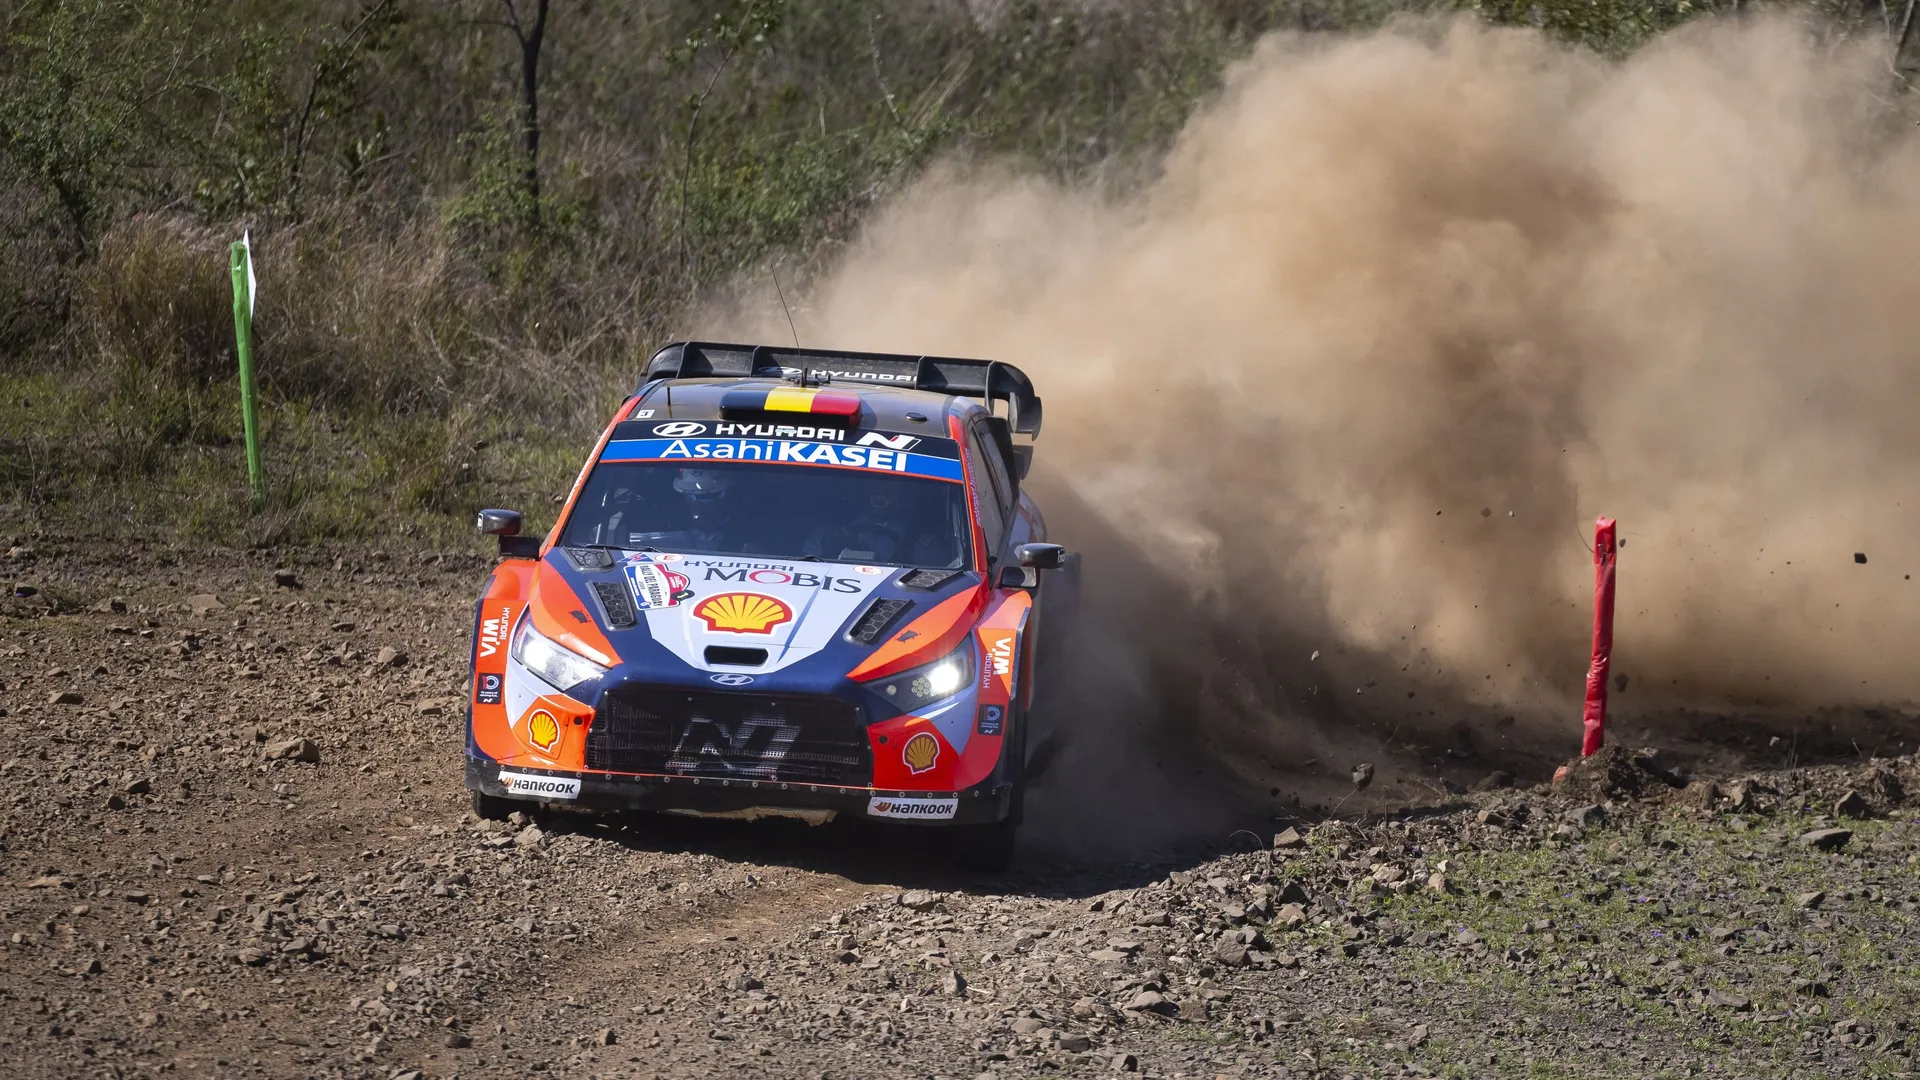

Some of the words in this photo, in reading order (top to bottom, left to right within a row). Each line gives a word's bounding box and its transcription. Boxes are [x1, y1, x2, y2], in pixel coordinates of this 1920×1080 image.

[715, 423, 846, 441] HYUNDAI
[683, 560, 795, 572] HYUNDAI
[703, 567, 862, 594] MOBIS
[480, 618, 501, 658] WIA
[499, 607, 511, 640] HYUNDAI
[983, 653, 994, 689] HYUNDAI
[991, 637, 1012, 676] WIA
